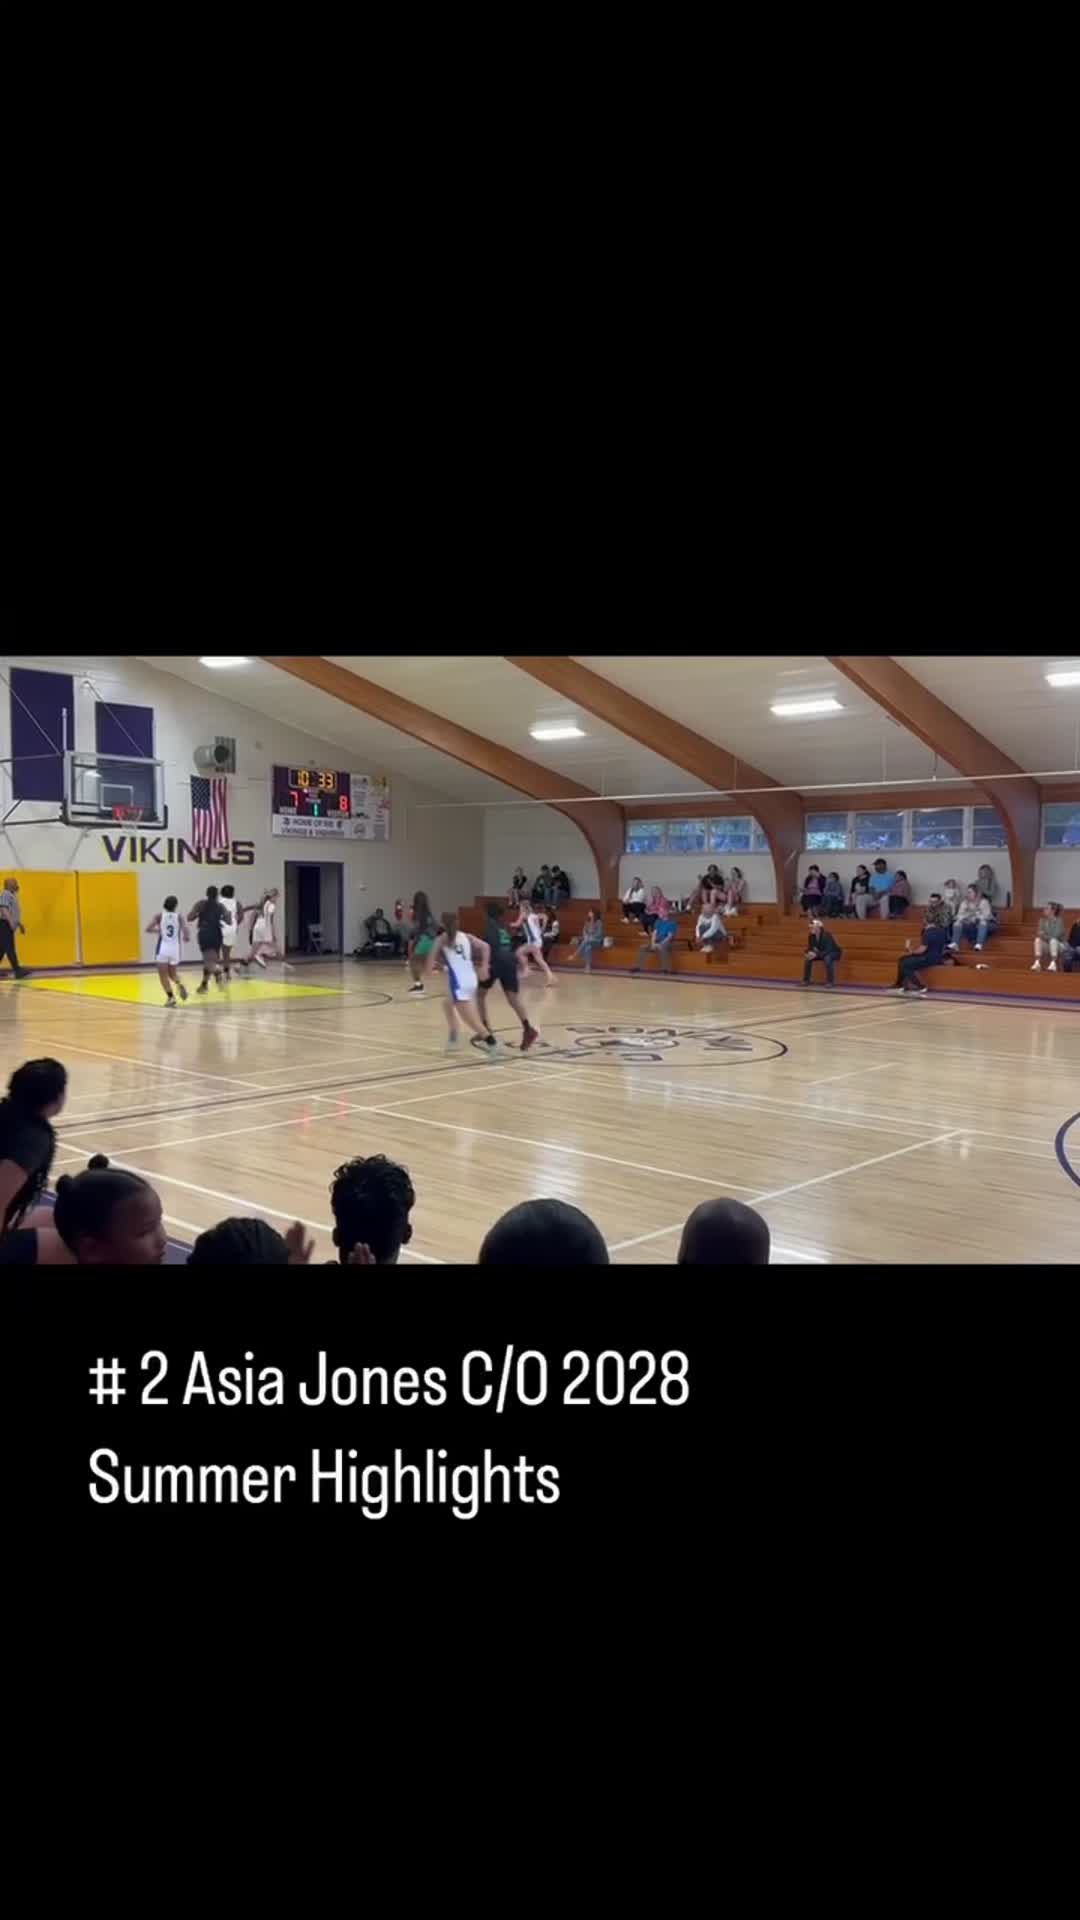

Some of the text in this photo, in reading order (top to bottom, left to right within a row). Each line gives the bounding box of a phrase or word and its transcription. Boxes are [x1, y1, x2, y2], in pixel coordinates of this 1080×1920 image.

[297, 770, 334, 789] 10 33
[289, 791, 298, 807] 7
[339, 795, 348, 811] 8
[102, 835, 255, 866] VIKINGS
[166, 925, 174, 937] 3
